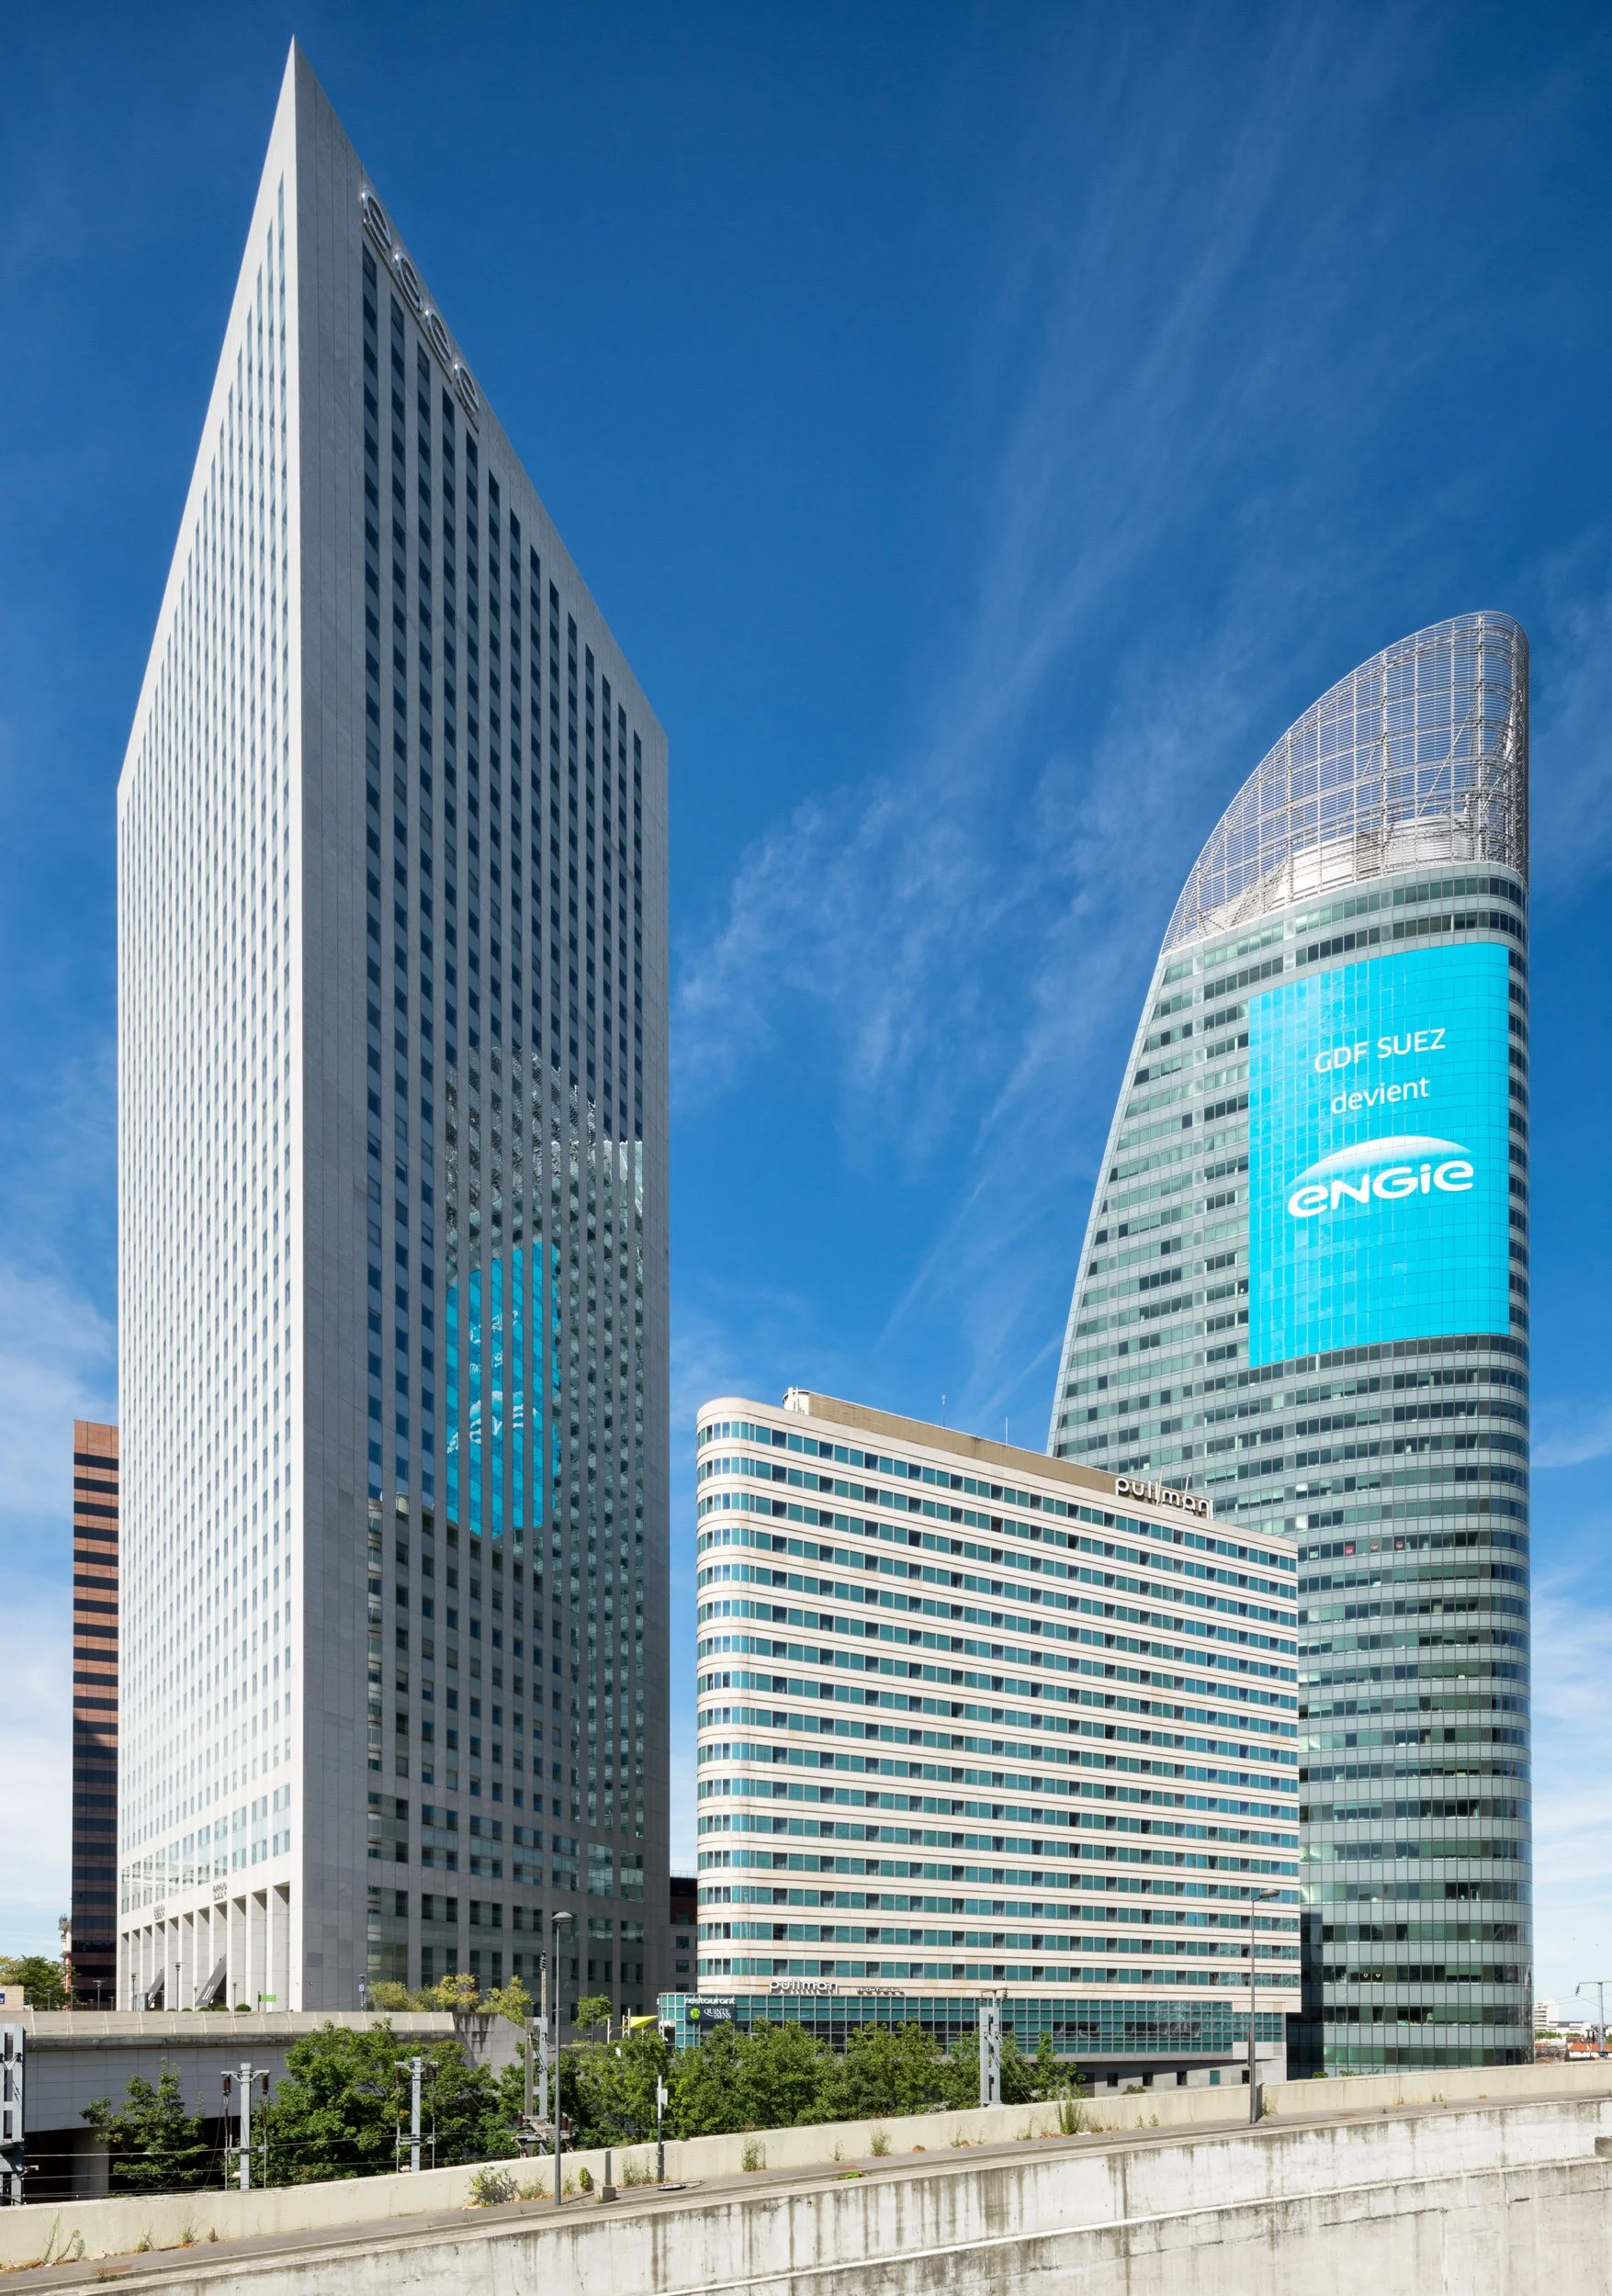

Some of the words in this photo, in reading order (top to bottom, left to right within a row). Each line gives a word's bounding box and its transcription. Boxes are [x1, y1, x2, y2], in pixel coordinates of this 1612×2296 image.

[1313, 1041, 1369, 1073] GDF
[1377, 1028, 1446, 1059] SUEZ
[1331, 1076, 1430, 1114] devient
[1115, 1478, 1210, 1519] pullman
[769, 1978, 838, 1995] pullman
[704, 2008, 729, 2017] QUINTE
